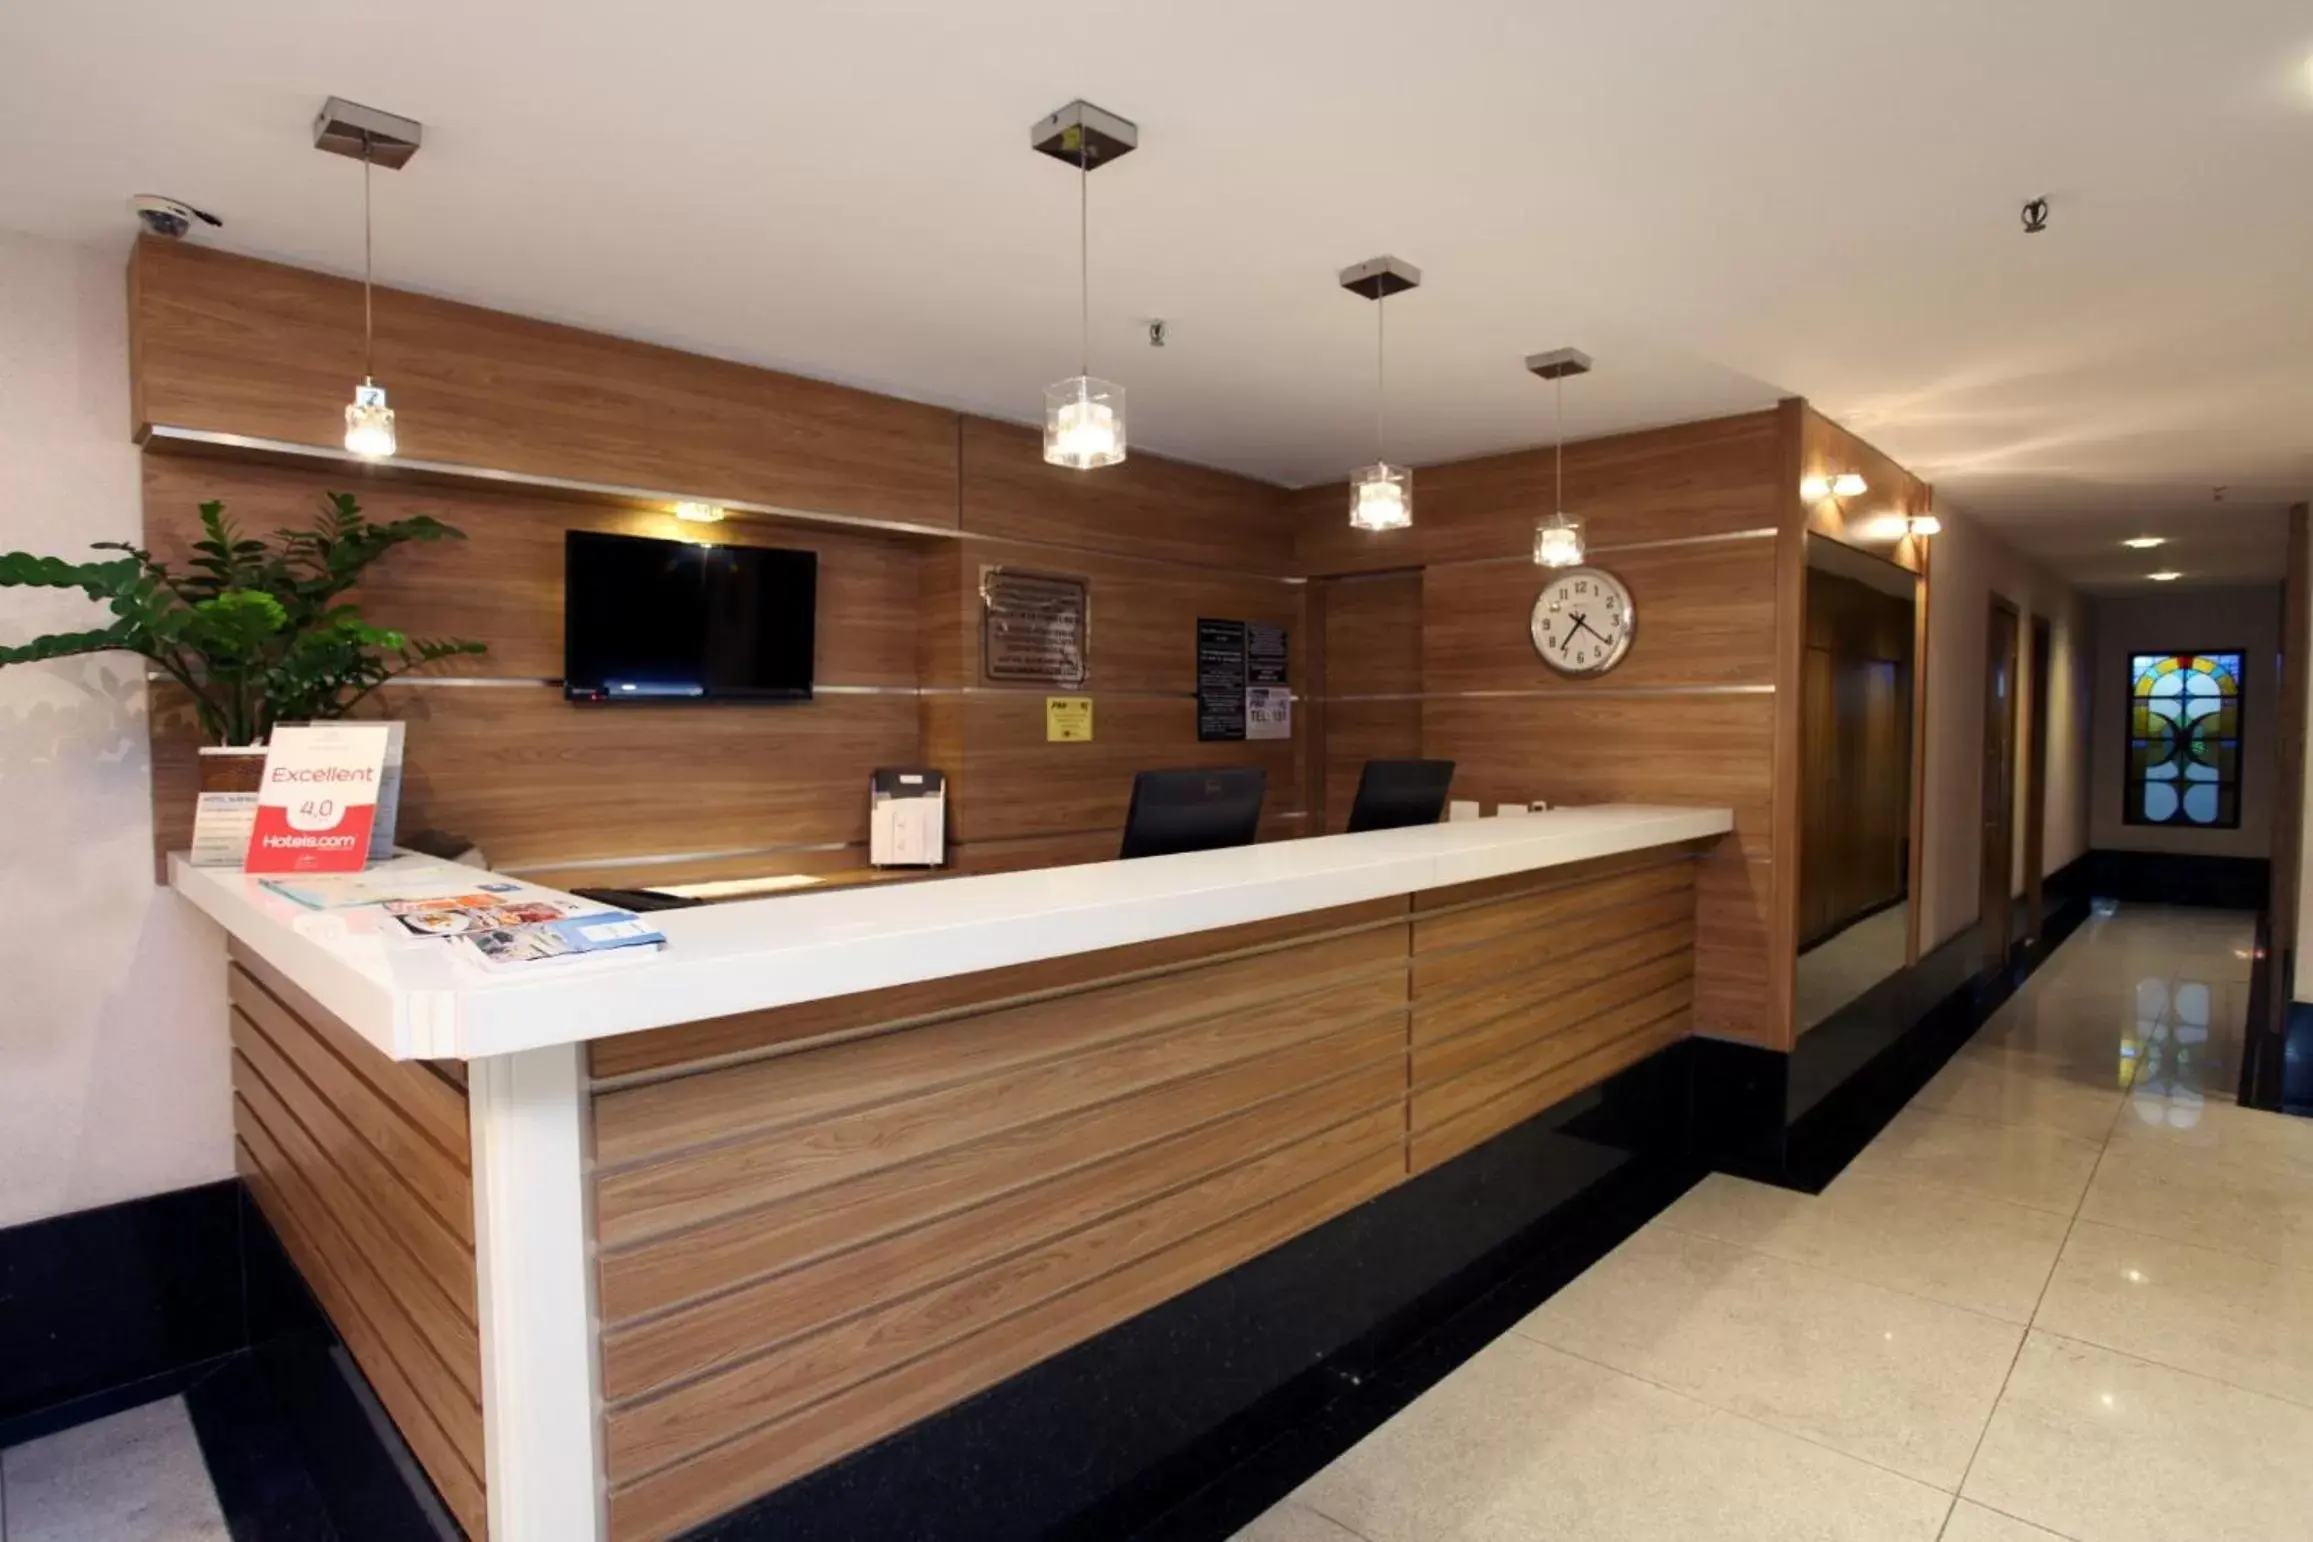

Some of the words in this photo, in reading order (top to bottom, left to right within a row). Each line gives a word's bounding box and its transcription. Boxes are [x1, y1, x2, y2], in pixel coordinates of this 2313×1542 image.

[1575, 581, 1587, 593] 12
[1594, 584, 1599, 597] 1
[1559, 588, 1568, 600] 11
[1606, 596, 1614, 609] 2
[1542, 619, 1550, 630] 9
[1611, 614, 1620, 627] 3
[1549, 636, 1556, 648] 8
[1604, 634, 1613, 645] 4
[1594, 645, 1602, 657] 5
[1577, 651, 1584, 664] 6
[271, 766, 374, 783] Excellent
[262, 833, 356, 849] Hotels.com
